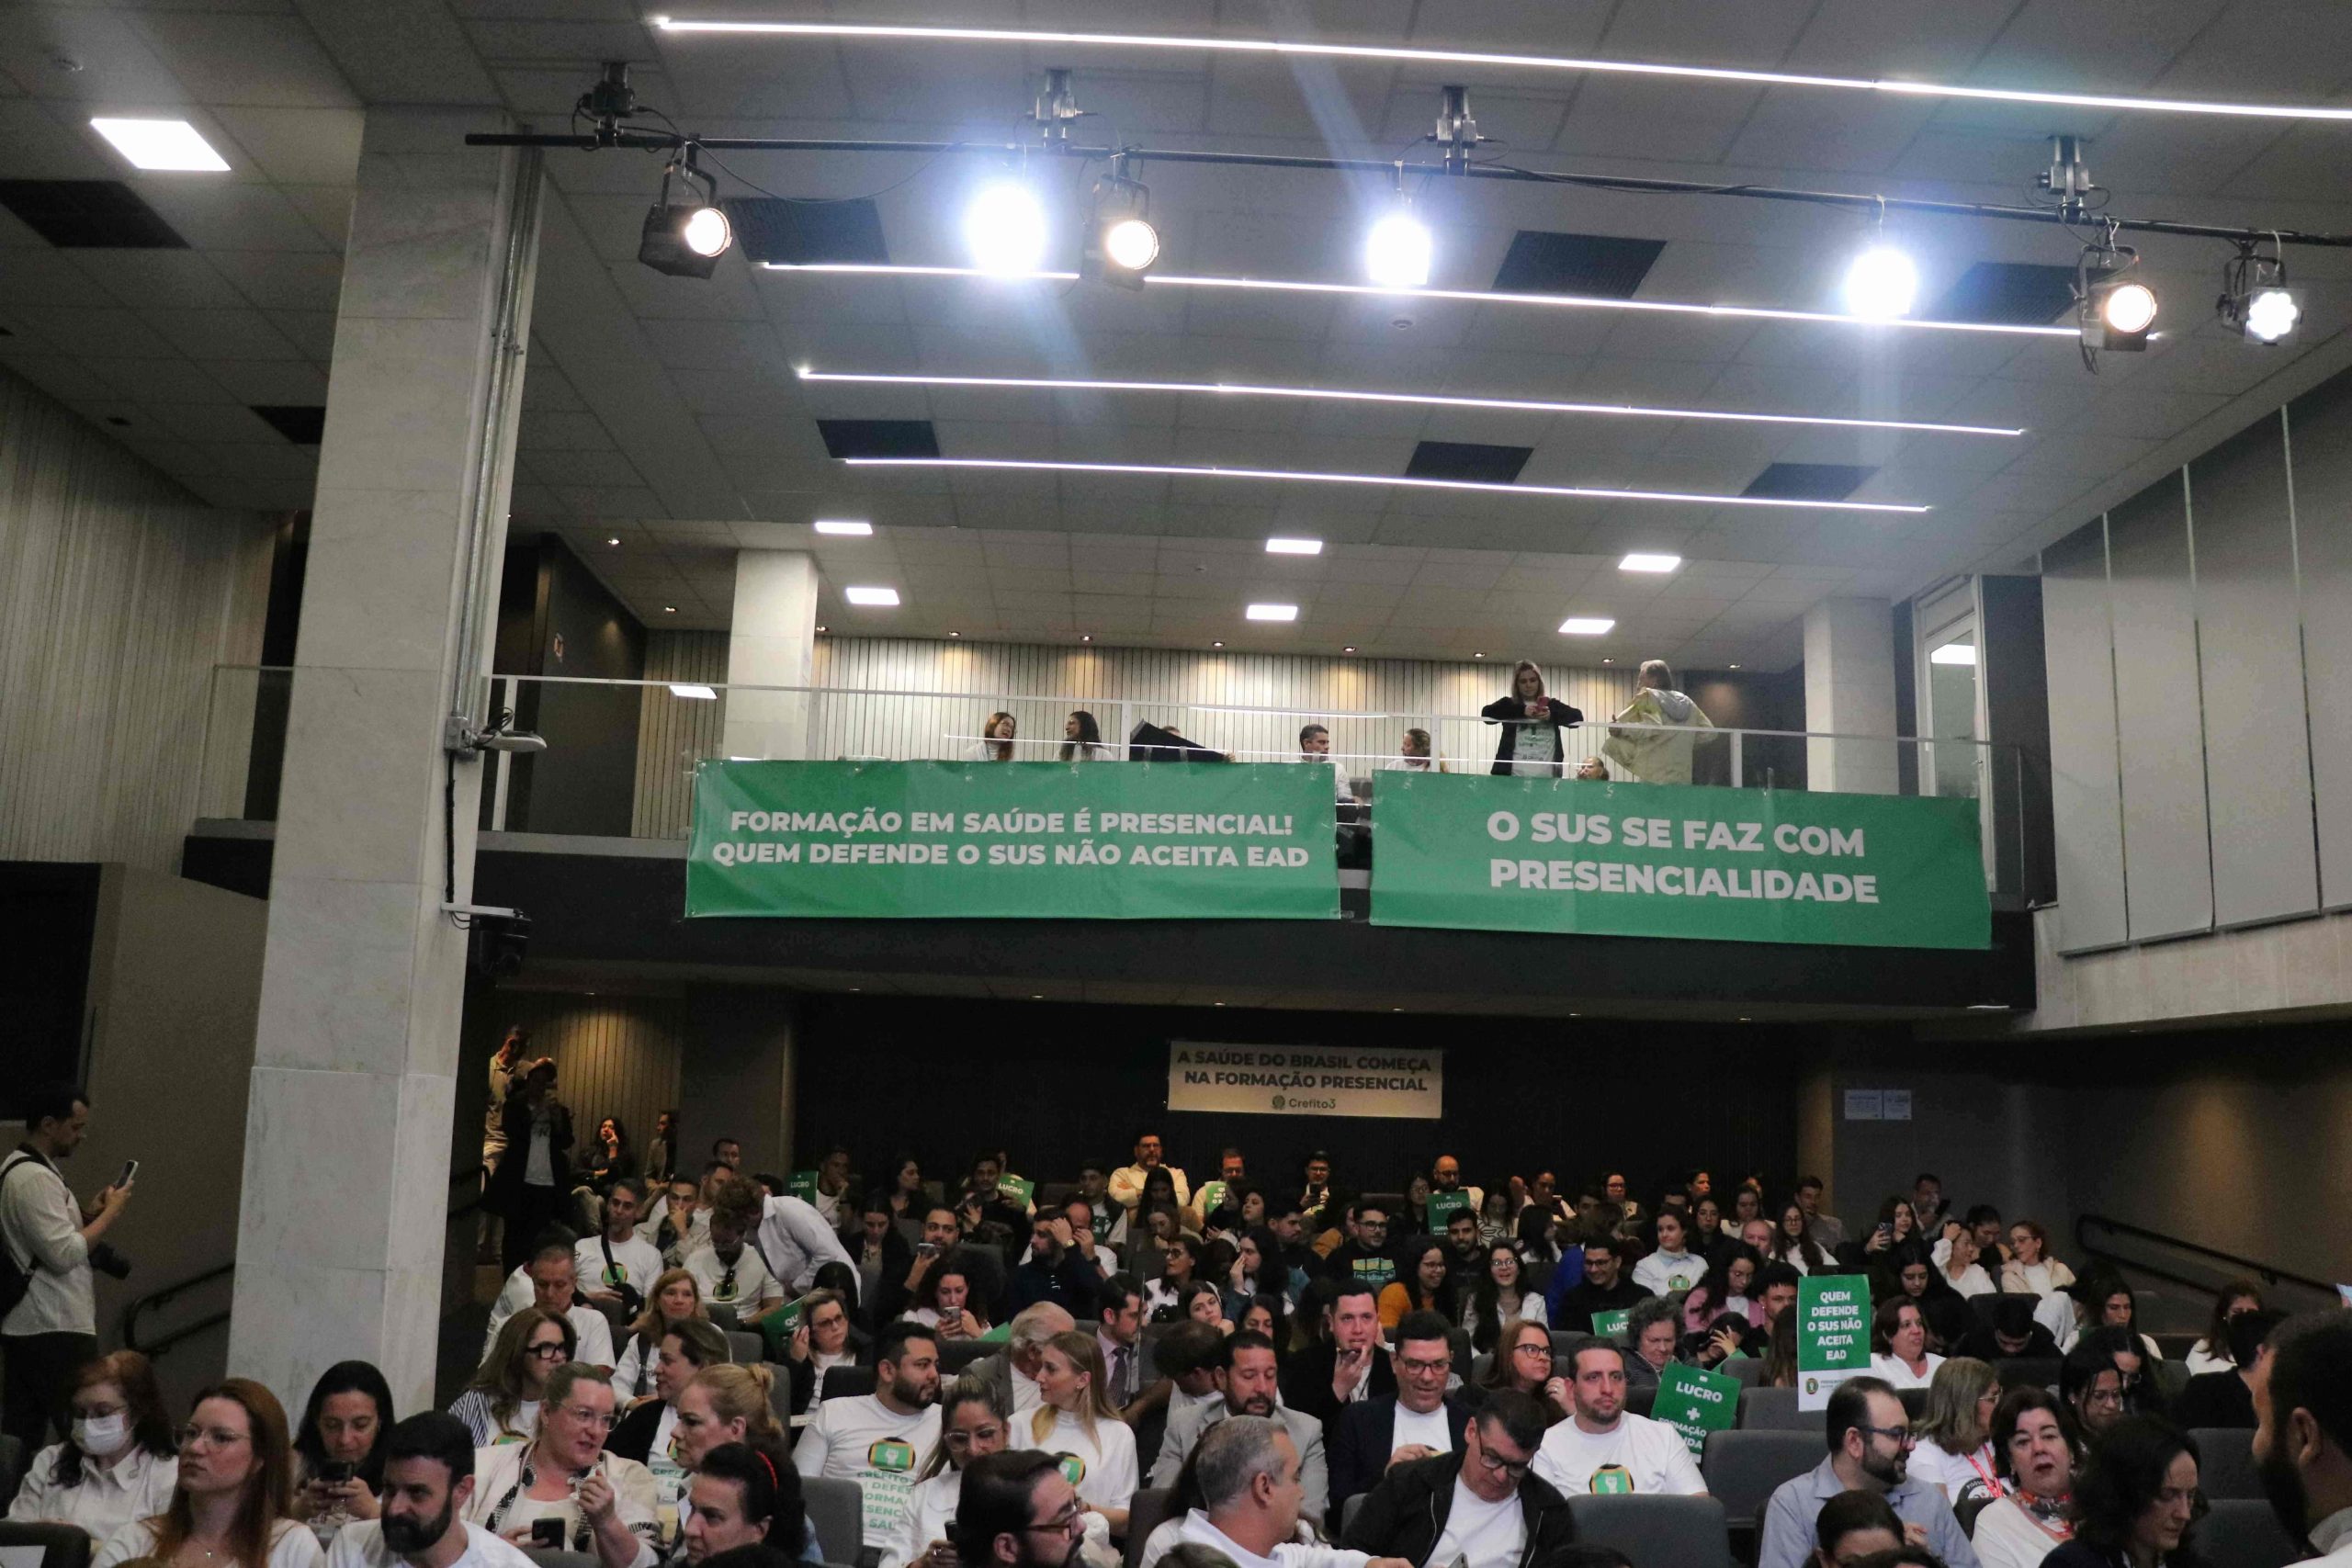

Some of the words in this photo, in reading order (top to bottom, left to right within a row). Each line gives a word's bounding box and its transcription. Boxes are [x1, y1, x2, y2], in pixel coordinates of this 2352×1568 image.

[731, 807, 901, 838] FORMAÇÃO
[910, 811, 955, 833] EM
[964, 807, 1064, 834] SAÚDE
[1073, 807, 1091, 833] É
[1101, 812, 1293, 836] PRESENCIAL!
[1487, 811, 1521, 841] O
[1532, 812, 1612, 845] SUS
[1622, 817, 1672, 849] SE
[1683, 820, 1765, 852] FAZ
[1773, 823, 1864, 857] COM
[713, 841, 800, 867] QUEM
[809, 843, 948, 865] DEFENDE
[957, 844, 980, 865] O
[989, 844, 1046, 865] SUS
[1055, 838, 1122, 866] NÃO
[1128, 844, 1239, 867] ACEITA
[1248, 846, 1309, 868] EAD
[1490, 858, 1880, 904] PRESENCIALIDADE
[1177, 1051, 1191, 1064] A
[1194, 1048, 1254, 1066] SAÚDE
[1259, 1053, 1285, 1067] DO
[1290, 1055, 1352, 1070] BRASIL
[1356, 1055, 1431, 1075] COMEÇA
[1184, 1070, 1210, 1084] NA
[1216, 1070, 1317, 1091] FORMAÇÃO
[1321, 1075, 1428, 1091] PRESENCIAL
[790, 1180, 810, 1189] LUCRO
[999, 1183, 1023, 1195] LUCRO
[1436, 1201, 1462, 1210] LUCRO
[1820, 1291, 1850, 1303] QUEM
[1812, 1305, 1860, 1317] DEFENDE
[1606, 1321, 1629, 1332] LUC
[1807, 1321, 1816, 1332] O
[1818, 1321, 1839, 1332] SUS
[1840, 1317, 1862, 1330] NÃO
[1817, 1335, 1853, 1347] ACEITA
[1826, 1349, 1847, 1360] EAD
[1676, 1381, 1723, 1403] LUCRO
